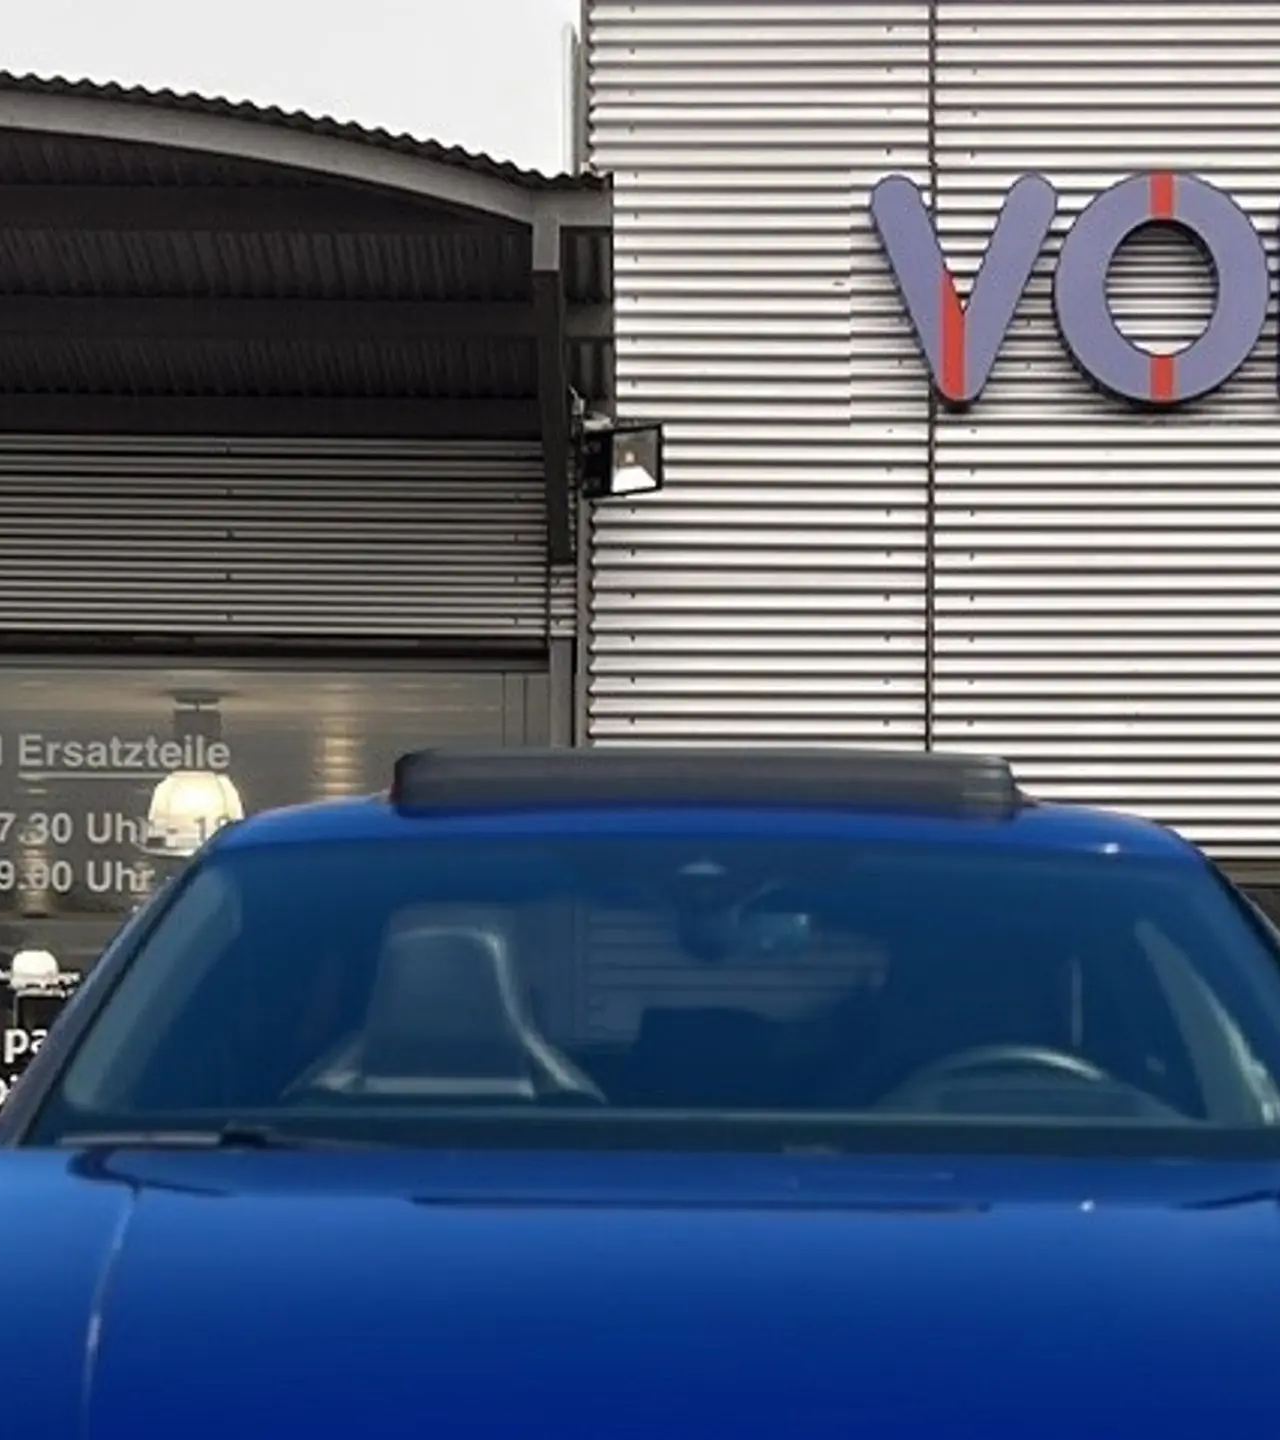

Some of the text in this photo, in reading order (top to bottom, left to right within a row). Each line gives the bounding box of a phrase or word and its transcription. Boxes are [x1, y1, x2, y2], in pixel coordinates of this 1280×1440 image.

[18, 733, 231, 769] Ersatzteile
[87, 812, 151, 844] Uhr
[87, 860, 155, 893] Uhr
